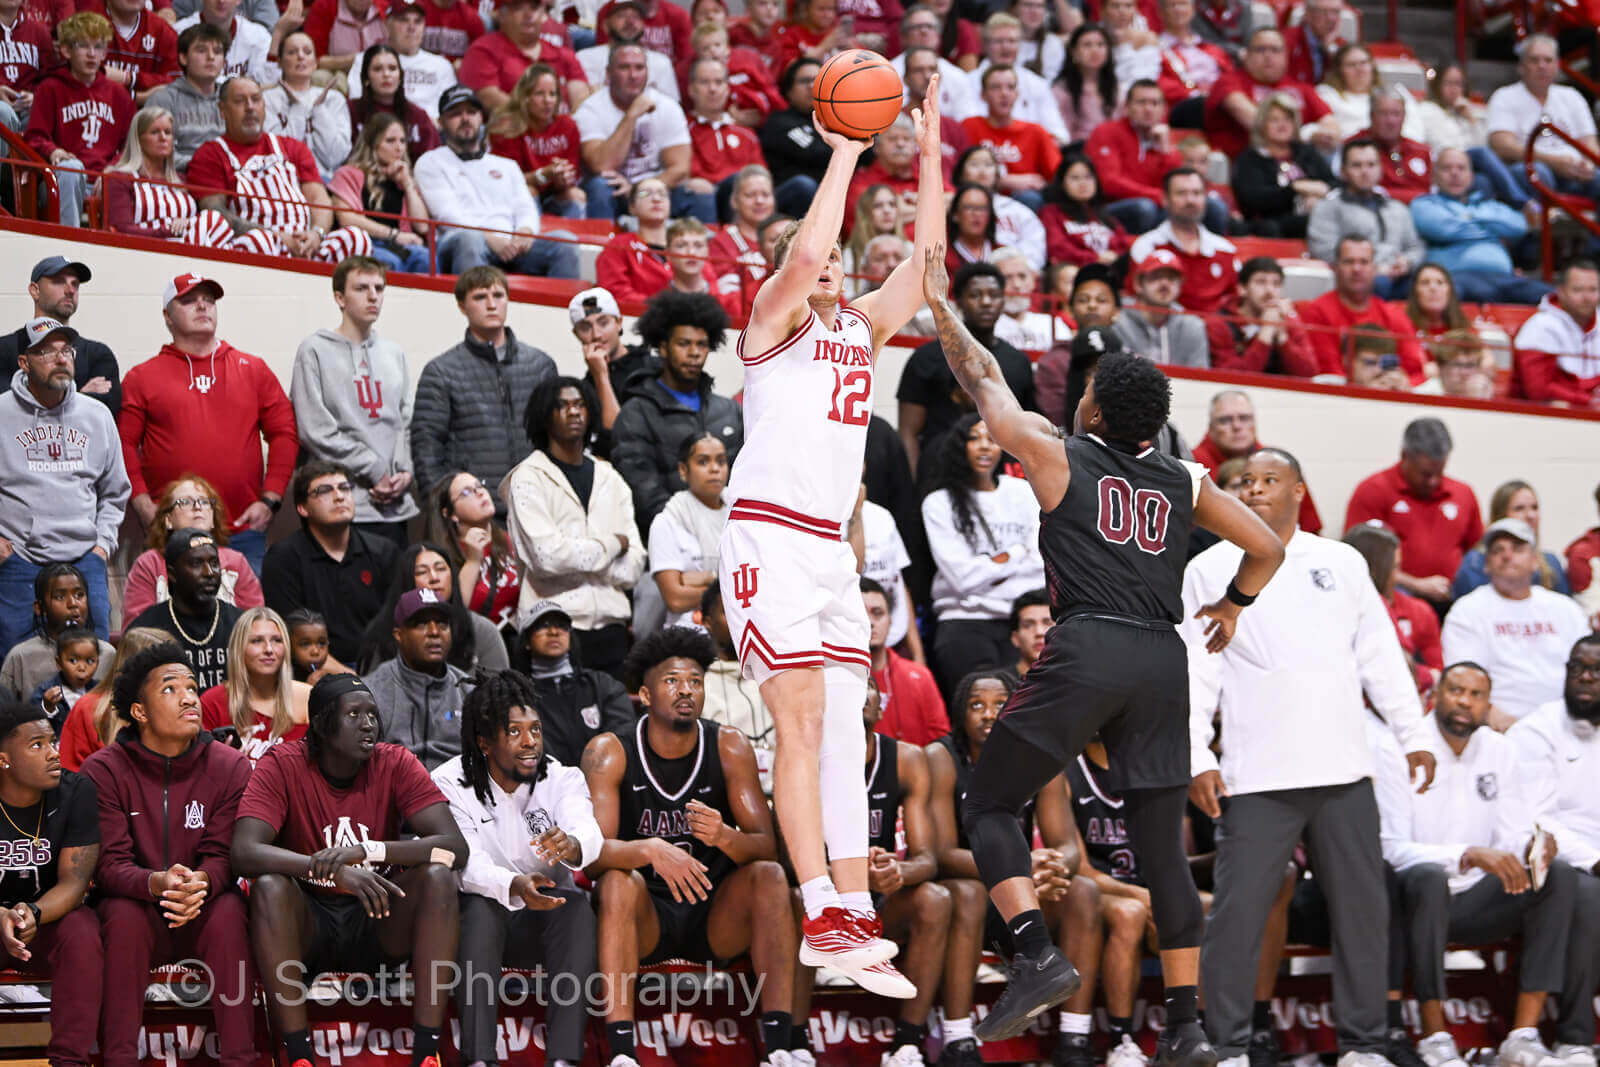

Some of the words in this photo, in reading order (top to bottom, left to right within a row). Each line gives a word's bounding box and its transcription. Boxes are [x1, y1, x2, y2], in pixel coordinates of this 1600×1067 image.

[62, 99, 115, 125] INDIANA
[813, 339, 873, 366] INDIAN
[827, 366, 872, 427] 12
[16, 424, 89, 448] INDIANA
[28, 461, 85, 473] HOOSIERS
[1097, 475, 1172, 556] 00
[198, 649, 213, 667] OF
[199, 669, 224, 689] ATE
[0, 838, 51, 867] 256
[312, 1021, 415, 1066] yVee
[632, 1012, 739, 1056] yVee
